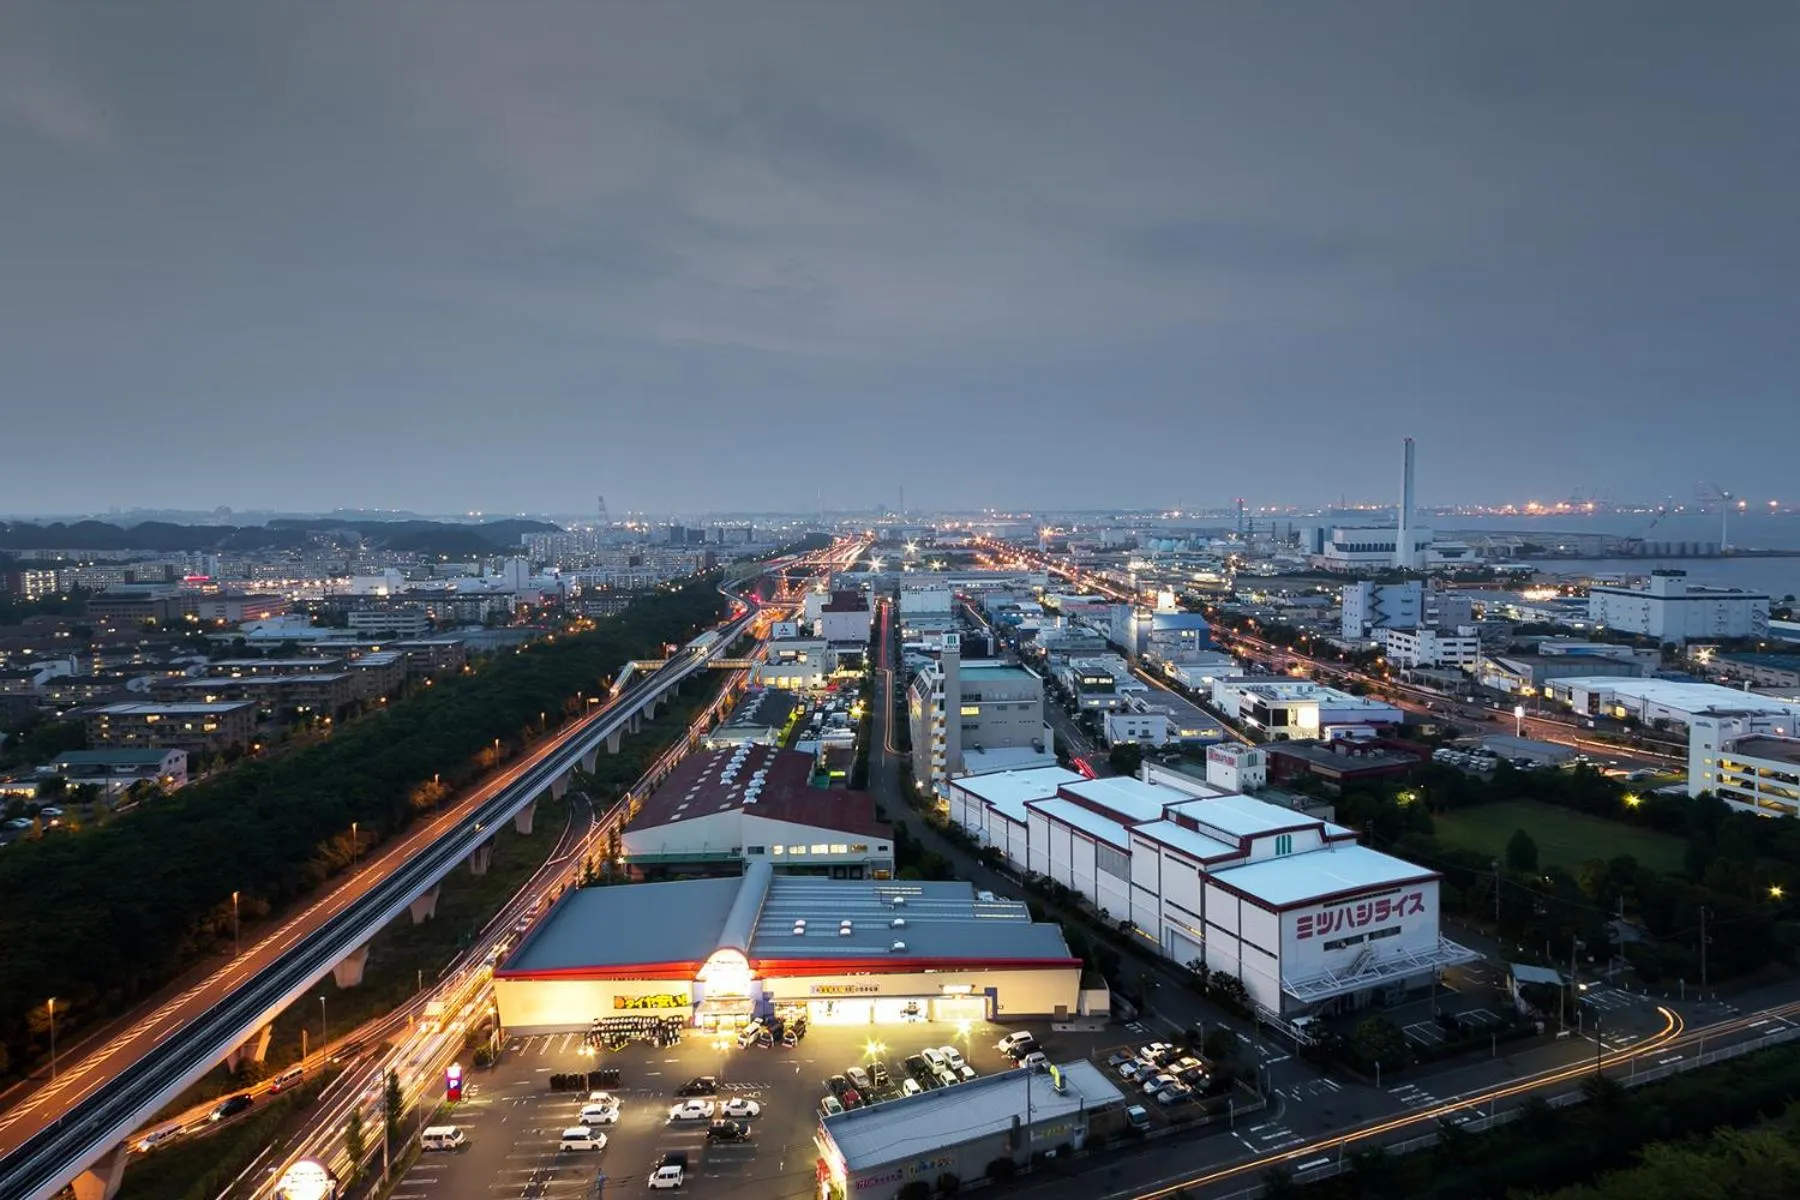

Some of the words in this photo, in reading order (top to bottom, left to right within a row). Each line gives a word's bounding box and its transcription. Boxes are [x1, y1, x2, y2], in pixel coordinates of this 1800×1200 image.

[1297, 892, 1424, 939] ミツハシライス
[449, 1079, 459, 1089] P
